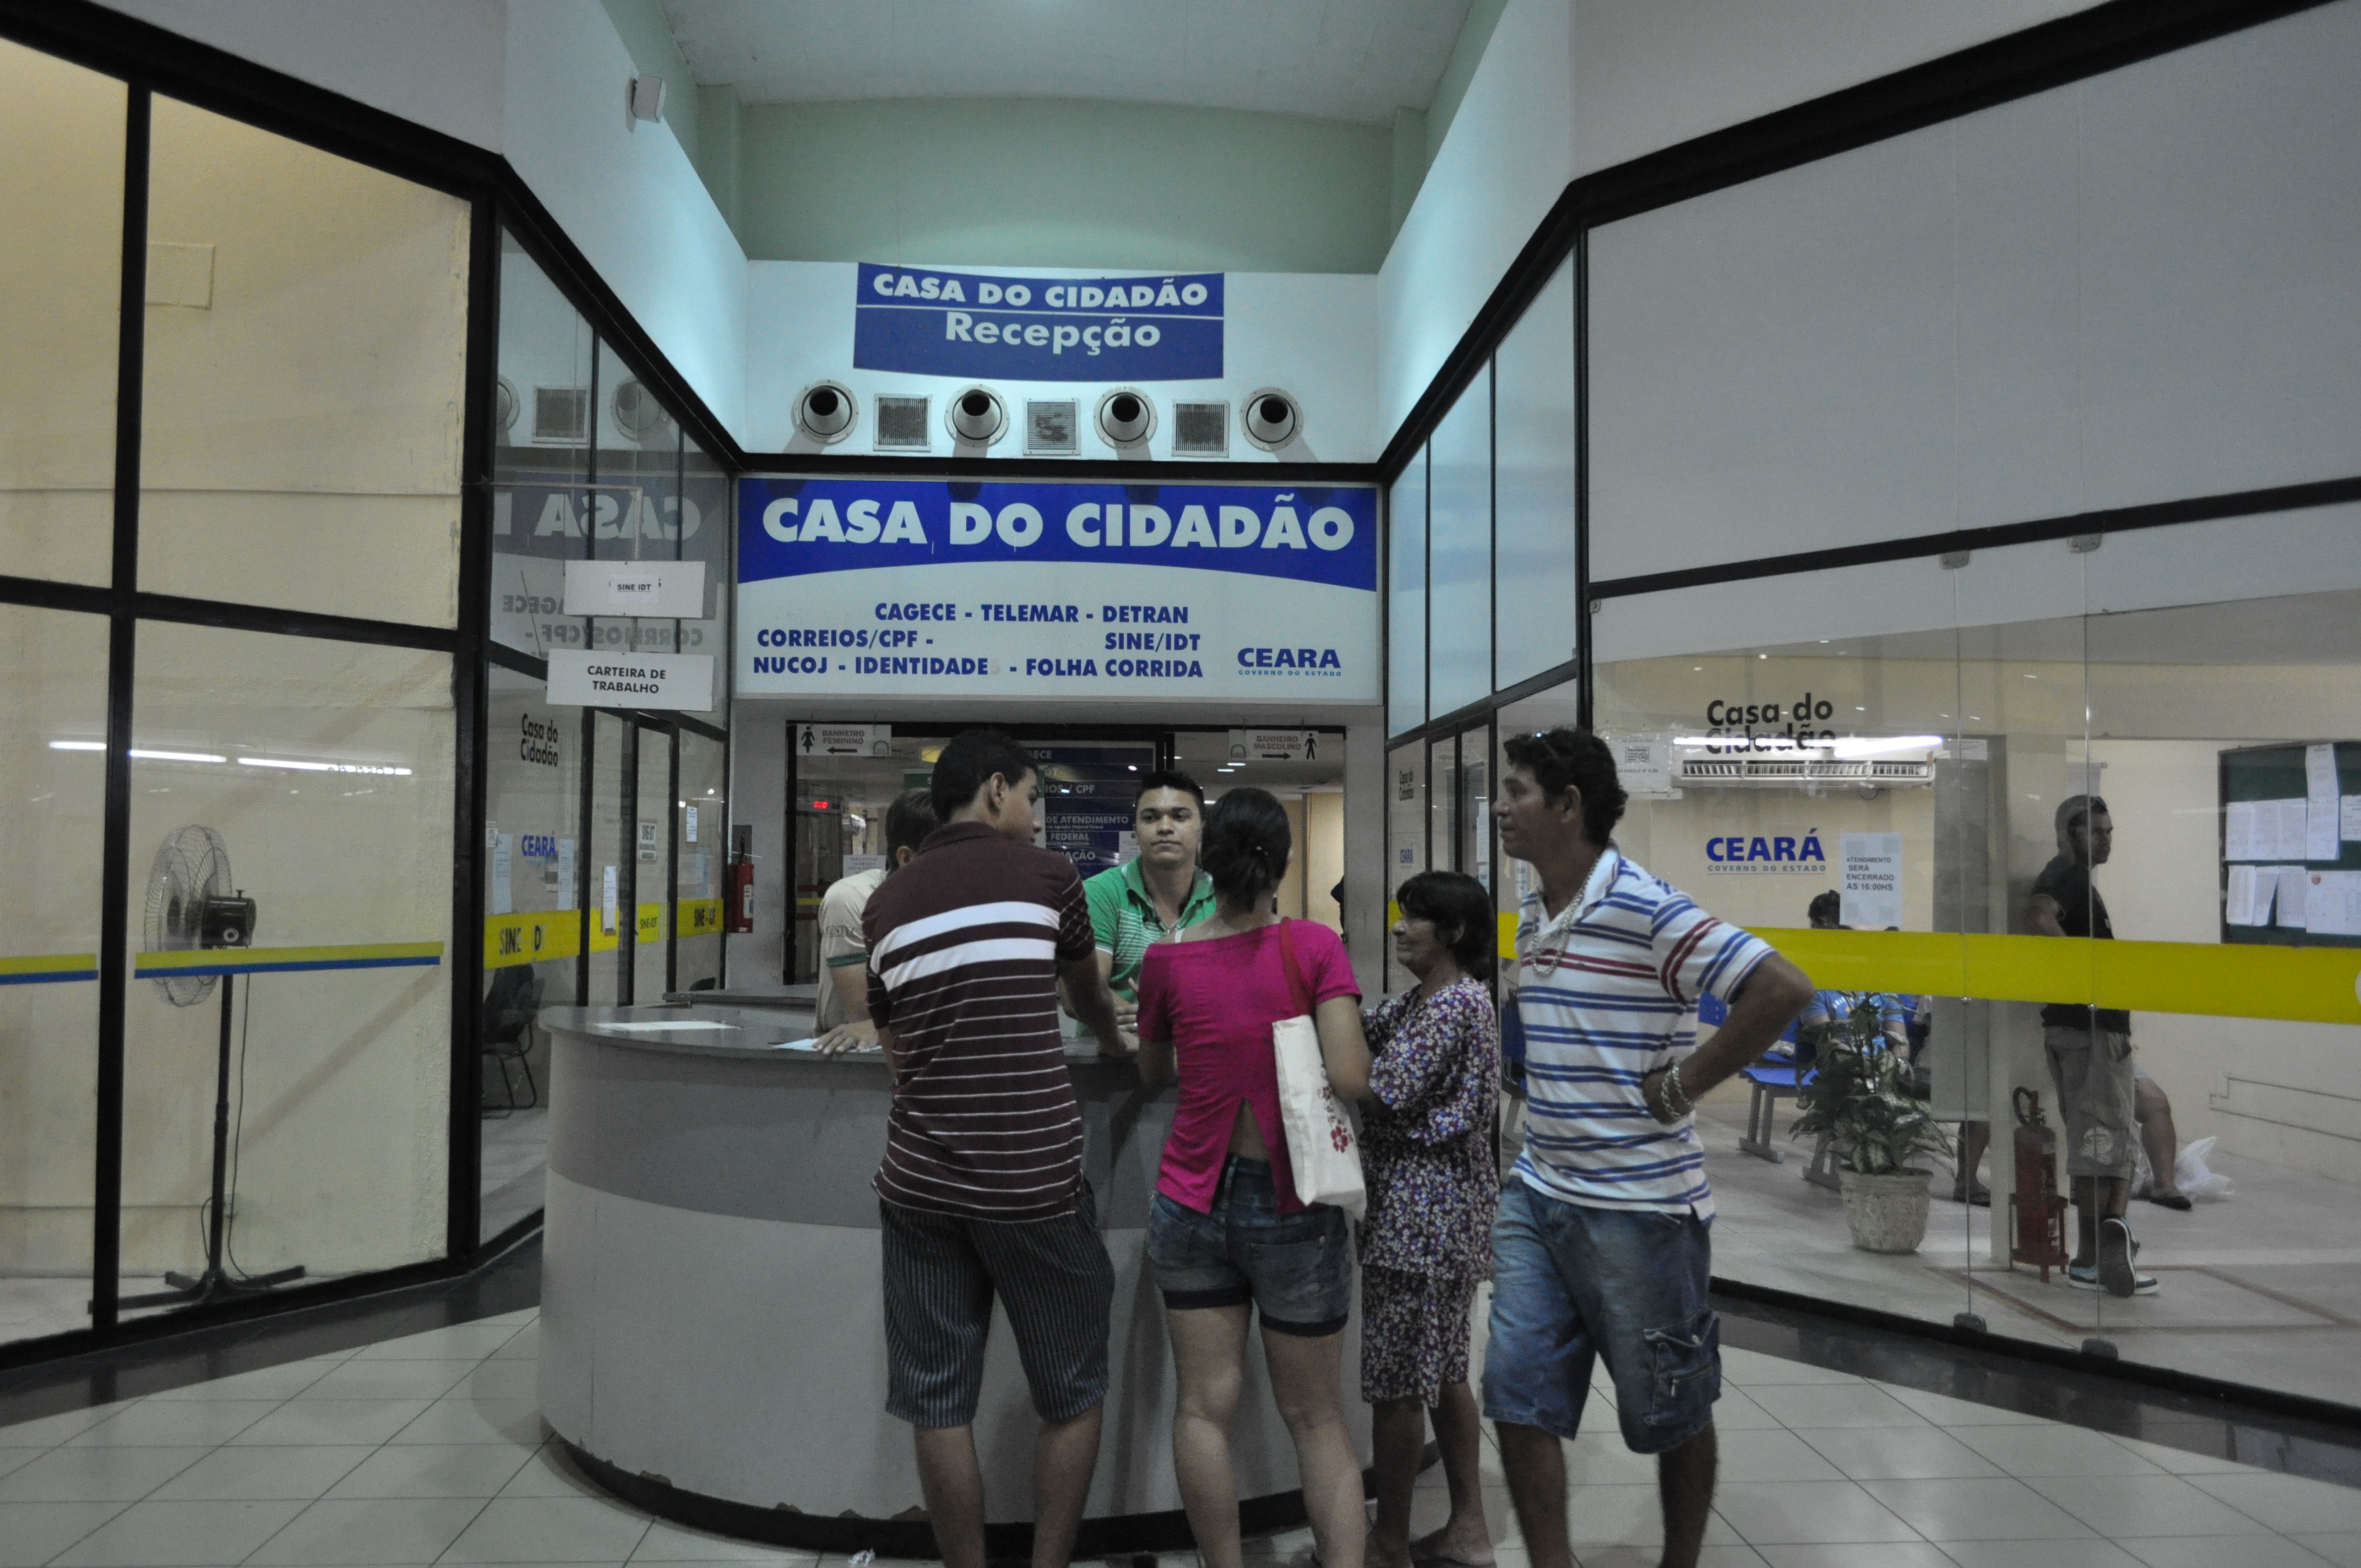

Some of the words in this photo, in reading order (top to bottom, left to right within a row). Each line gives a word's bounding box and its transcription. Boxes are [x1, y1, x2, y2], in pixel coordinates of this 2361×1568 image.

[874, 274, 965, 302] CASA
[978, 284, 1031, 306] DO
[1045, 278, 1207, 307] CIDADÃO
[946, 312, 1160, 356] Recepção
[763, 498, 927, 544] CASA
[950, 502, 1043, 547] DO
[1066, 493, 1354, 551] CIDADÃO
[875, 603, 956, 620] CAGECE
[981, 604, 1079, 622] TELEMAR
[1103, 606, 1188, 623] DETRAN
[757, 629, 918, 649] CORREIOS/CPF
[1105, 633, 1200, 652] SINE/IDT
[753, 657, 828, 674] NUCOJ
[855, 657, 988, 675] IDENTIDADE
[1026, 658, 1098, 677] FOLHA
[1105, 659, 1203, 678] CORRIDA
[1237, 647, 1341, 668] CEARA
[587, 666, 646, 678] CARTEIRA
[650, 669, 666, 679] DE
[592, 680, 659, 694] TRABALHO
[1707, 700, 1779, 726] Casa
[1793, 692, 1833, 721] do
[522, 713, 544, 739] Casa
[547, 720, 558, 743] do
[1705, 722, 1836, 754] Cidadão
[521, 738, 558, 767] Cidadão
[1076, 785, 1095, 793] CPF
[1060, 816, 1128, 824] ATENDIMENTO
[522, 831, 556, 856] CEARÁ
[1706, 827, 1825, 862] CEARÁ
